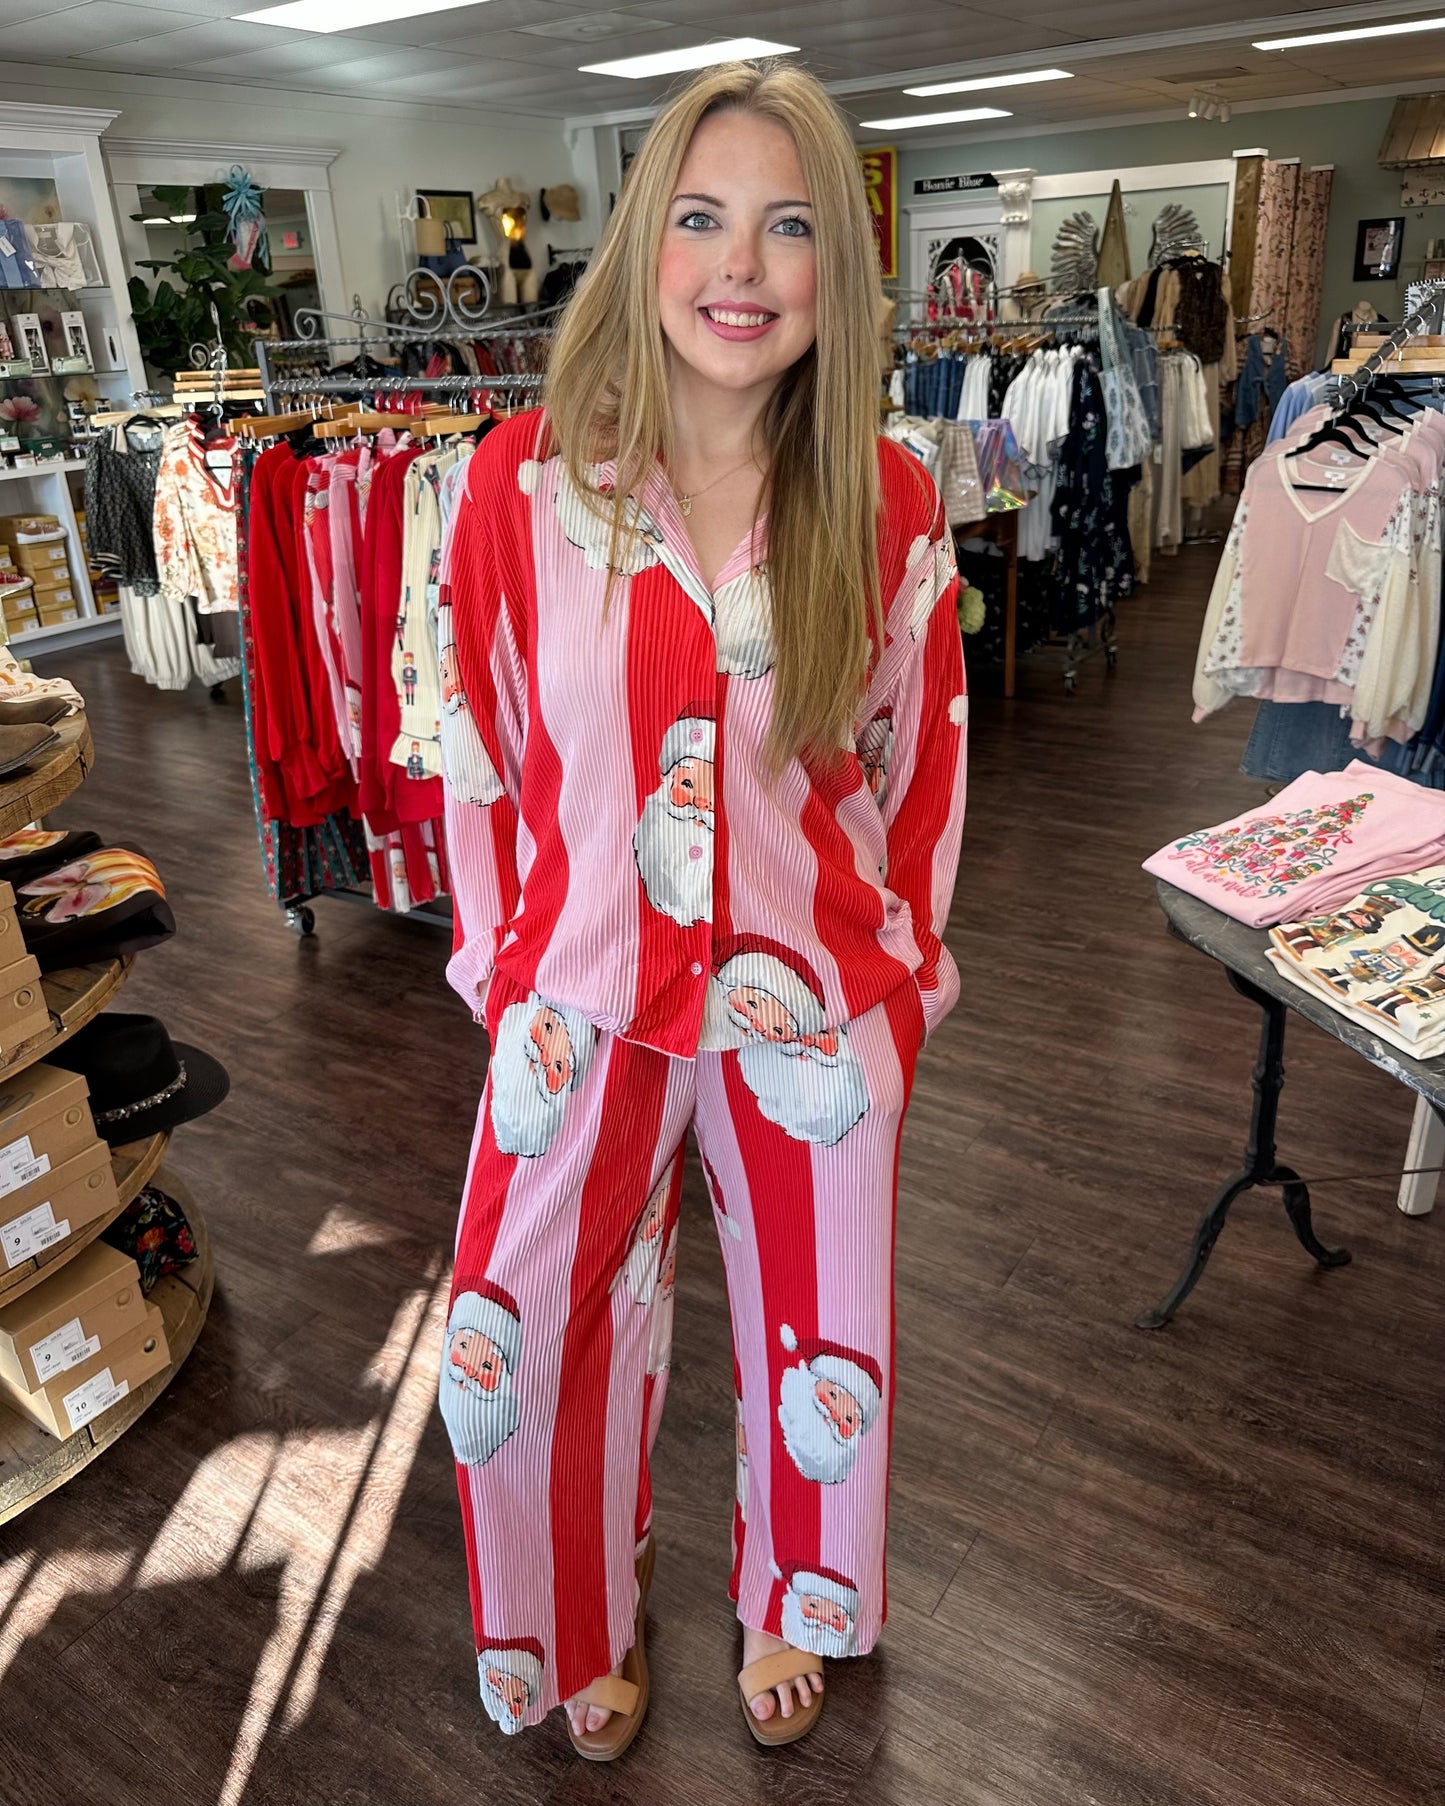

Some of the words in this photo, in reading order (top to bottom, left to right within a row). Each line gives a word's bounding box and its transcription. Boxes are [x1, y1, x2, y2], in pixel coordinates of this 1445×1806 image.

[1222, 881, 1261, 897] nuts
[14, 1237, 21, 1246] 9
[45, 1353, 51, 1362] 9
[75, 1402, 87, 1413] 10
